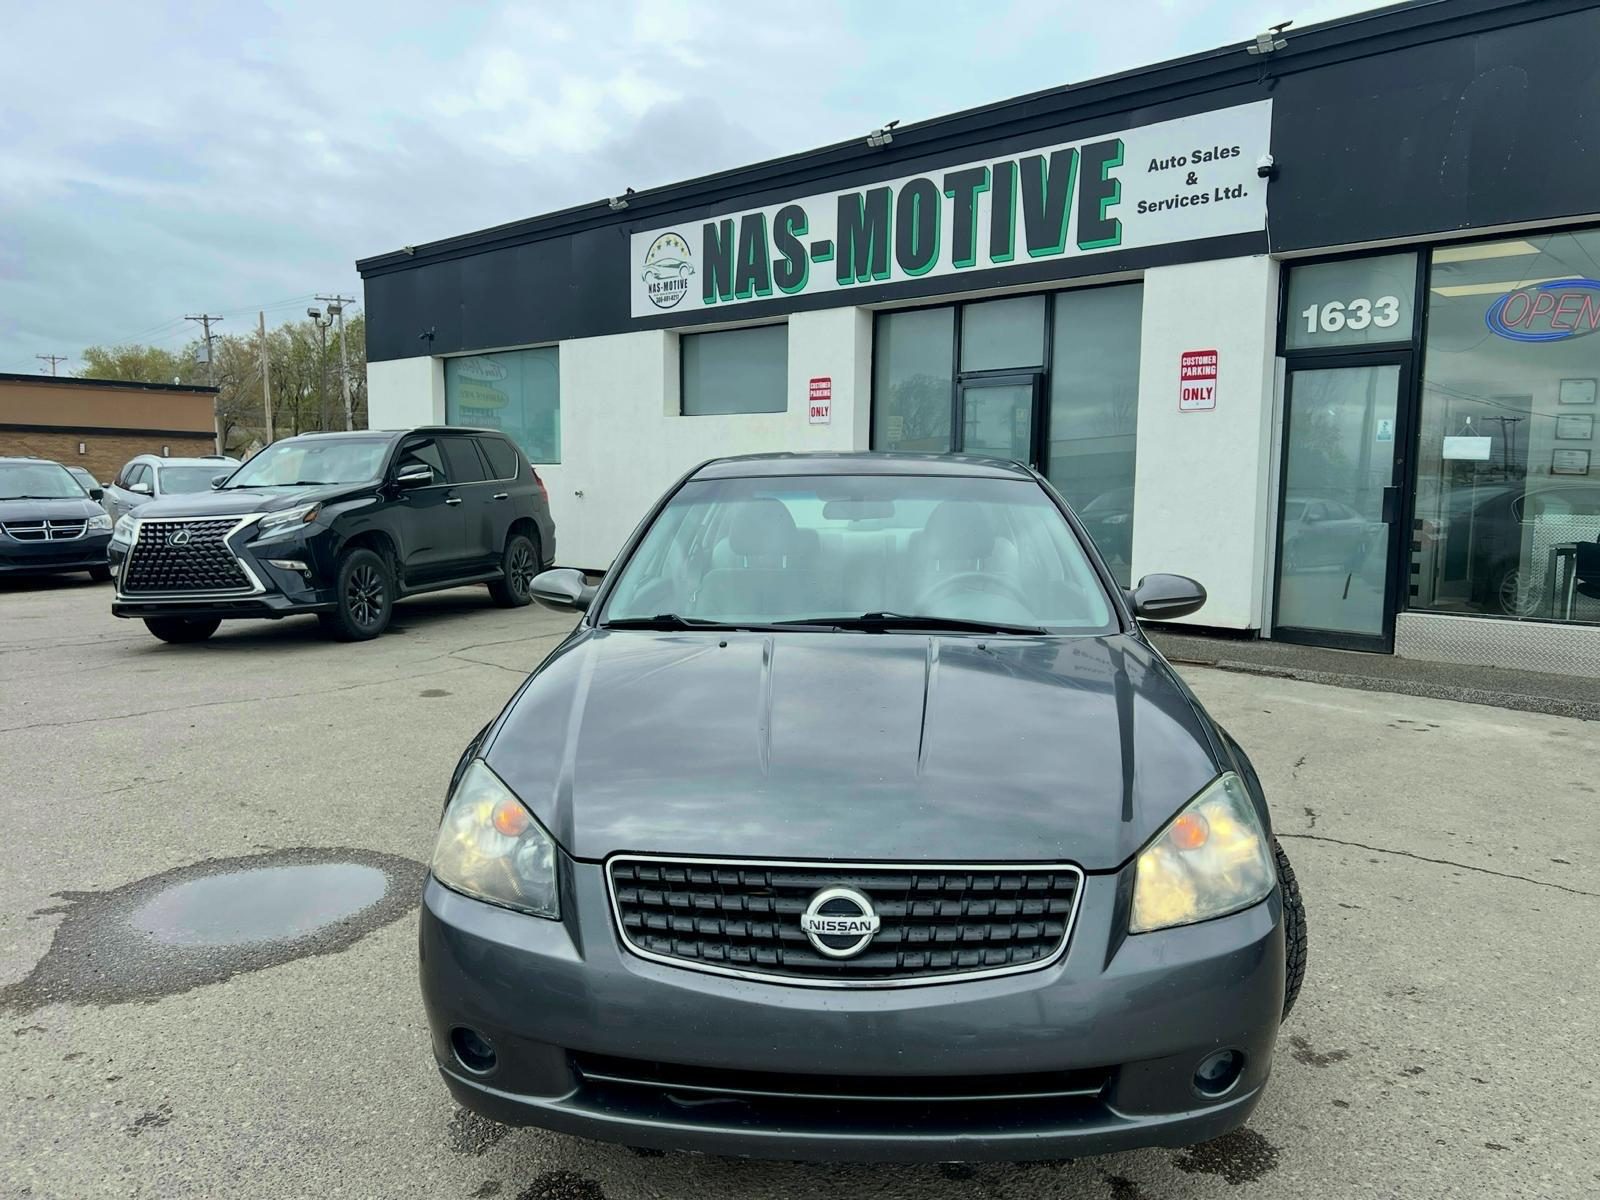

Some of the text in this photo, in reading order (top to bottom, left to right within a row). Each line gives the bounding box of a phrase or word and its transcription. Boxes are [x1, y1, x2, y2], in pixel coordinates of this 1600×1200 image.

[1148, 145, 1240, 172] Auto Sales
[1185, 172, 1199, 186] &
[1137, 184, 1248, 214] Services Ltd.
[703, 138, 1125, 305] NAS-MOTIVE
[648, 279, 688, 294] NAS-MOTIVE
[1302, 296, 1400, 333] 1633
[1502, 292, 1600, 331] OPEN
[1182, 355, 1217, 366] CUSTOMER
[1182, 365, 1216, 377] PARKING
[1183, 387, 1213, 401] ONLY
[811, 406, 828, 417] ONLY
[809, 920, 871, 931] NISSAN
